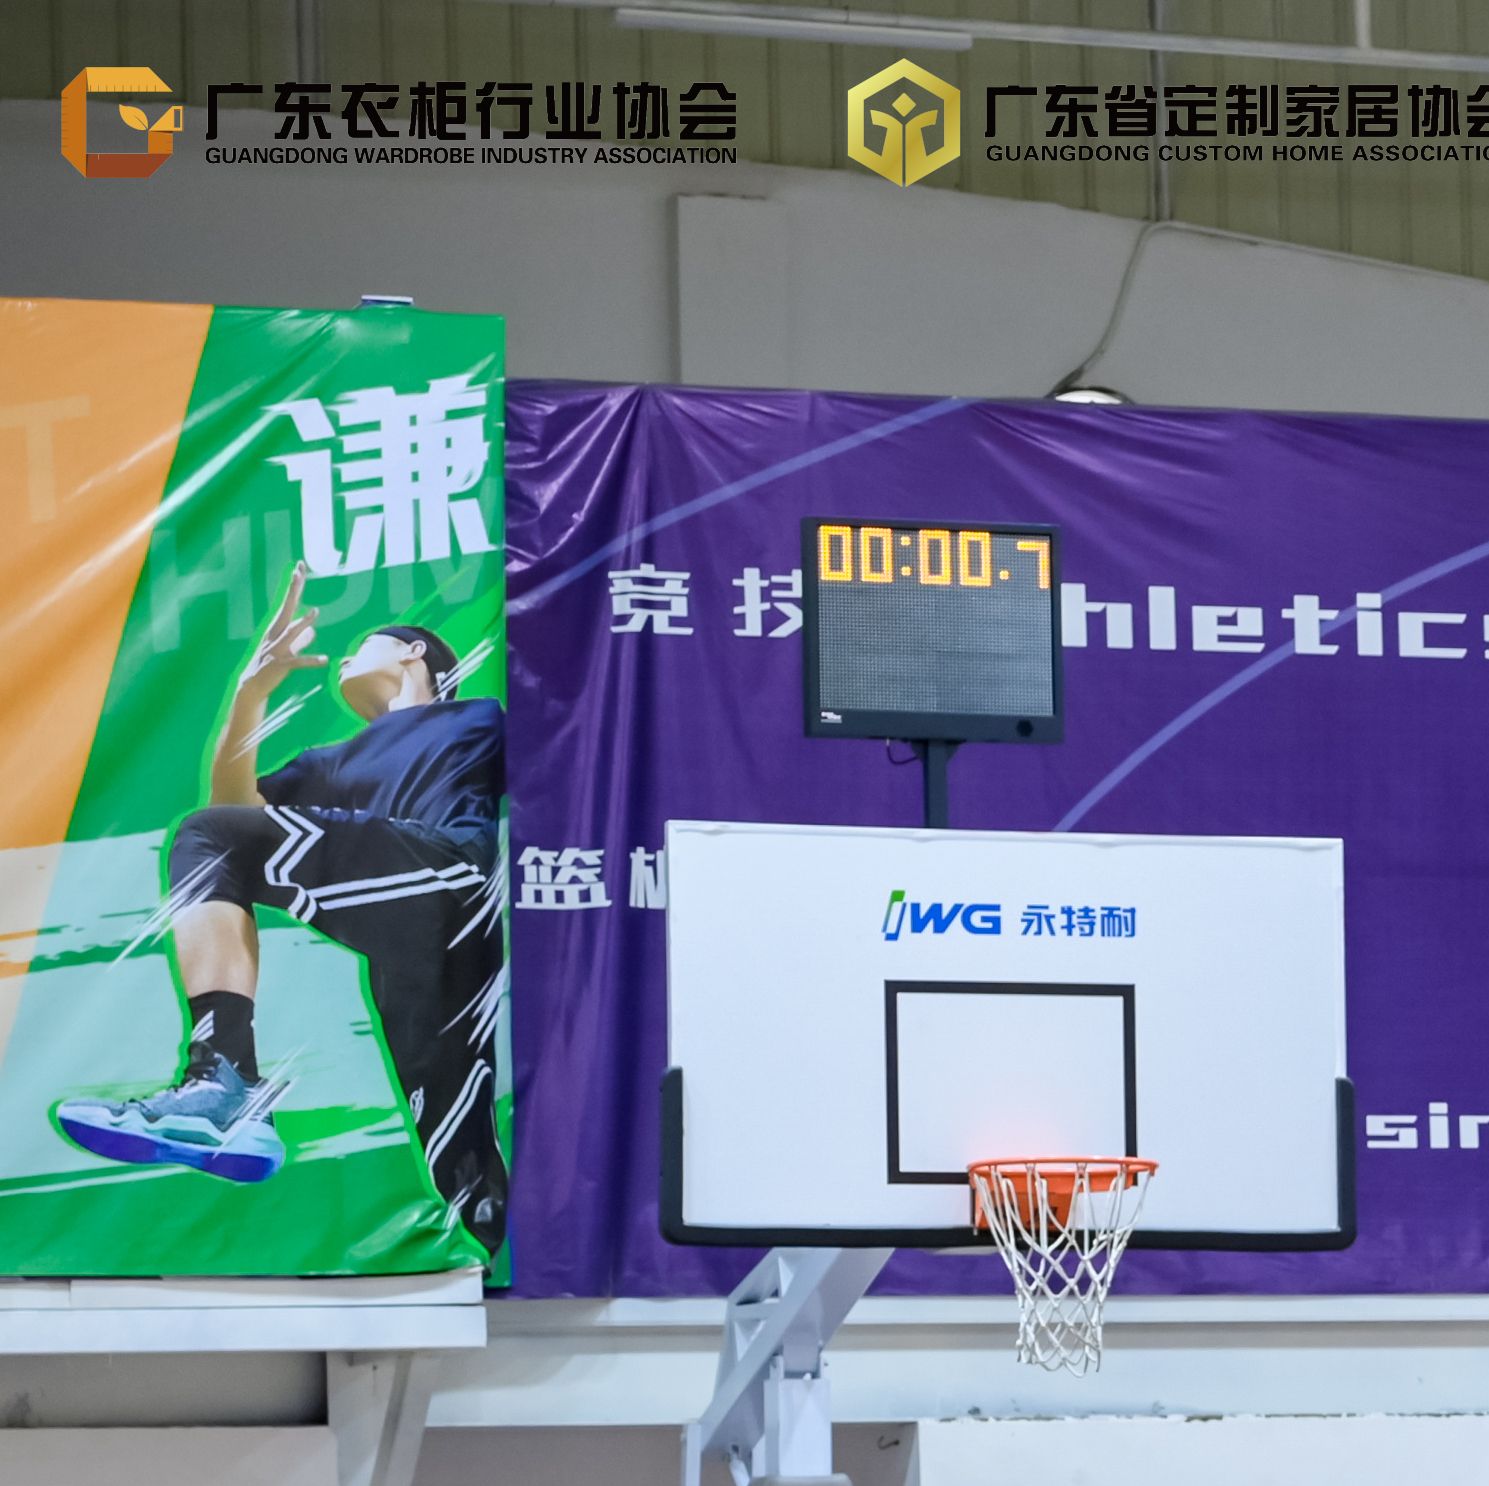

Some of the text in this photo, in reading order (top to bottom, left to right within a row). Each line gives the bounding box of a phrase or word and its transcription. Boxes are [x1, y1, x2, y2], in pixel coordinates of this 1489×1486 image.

[262, 370, 500, 579] 谦
[1020, 905, 1137, 938] 永特耐
